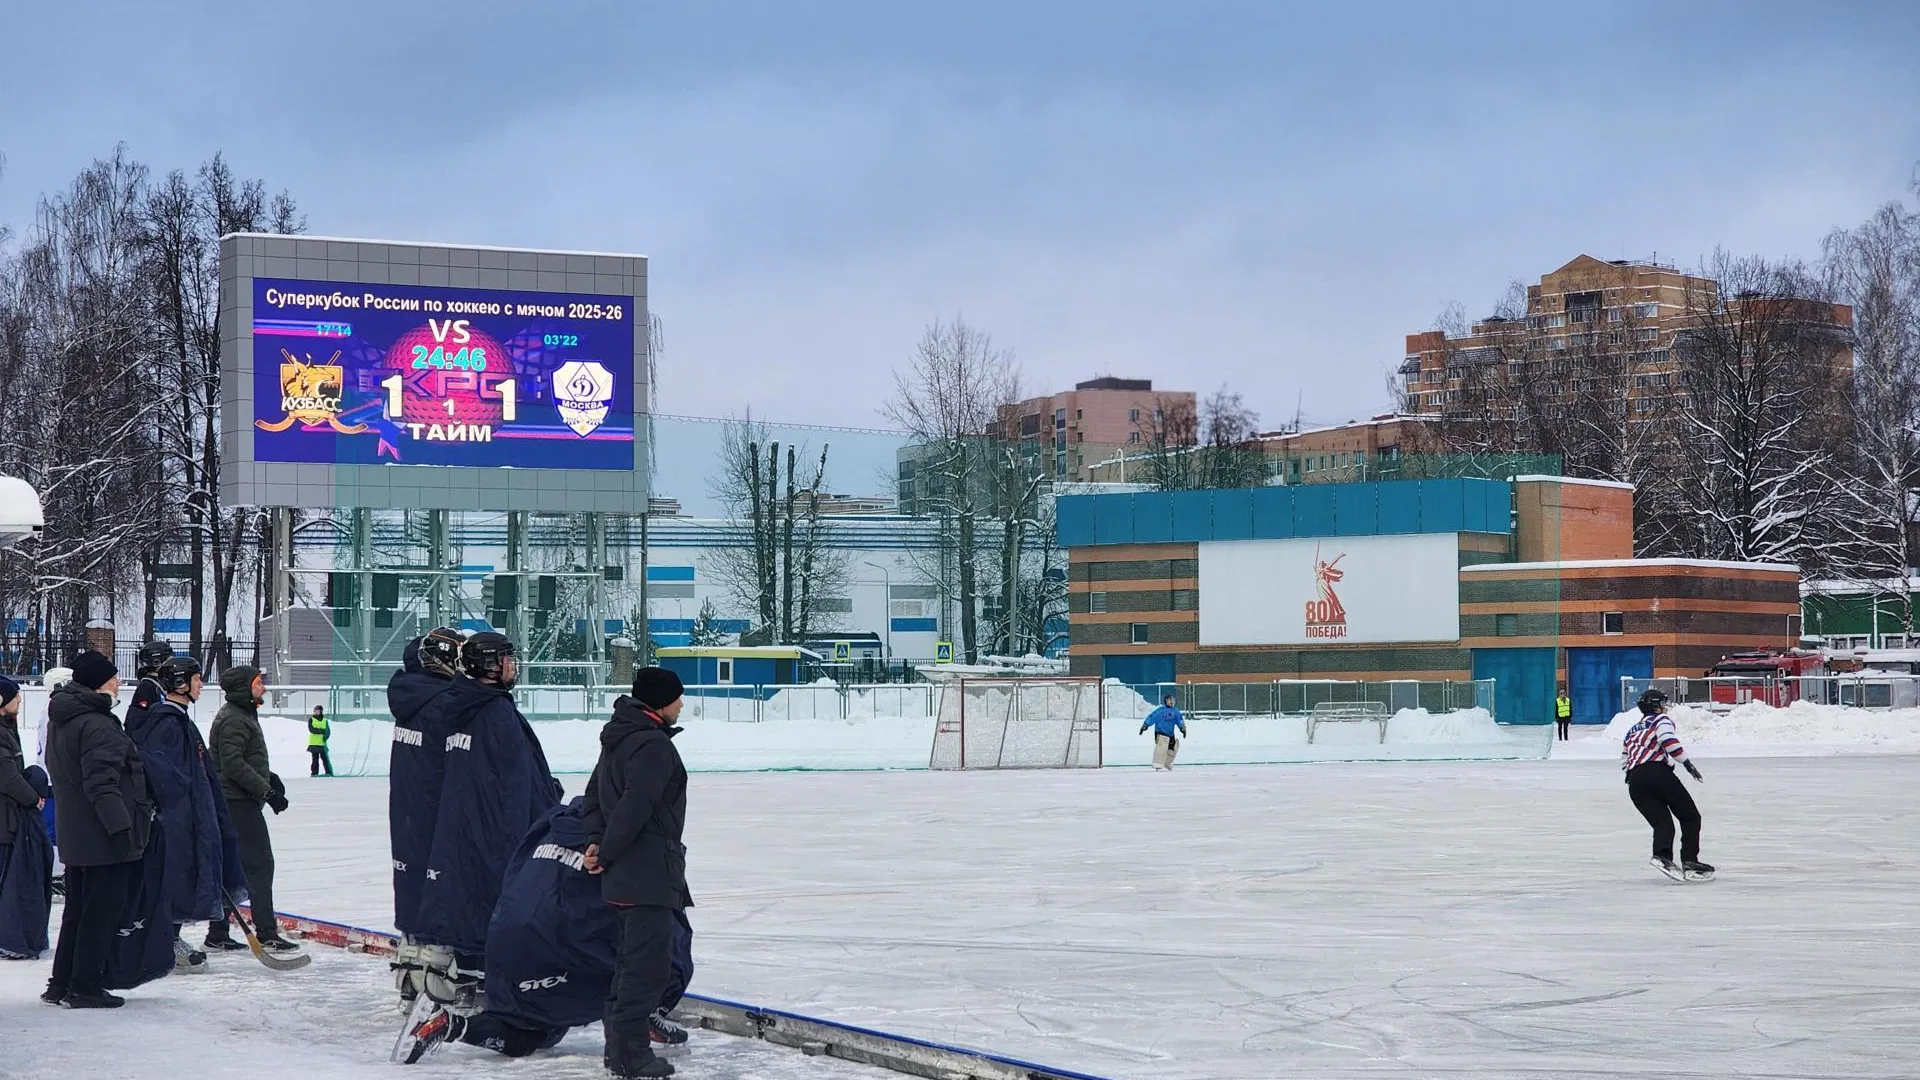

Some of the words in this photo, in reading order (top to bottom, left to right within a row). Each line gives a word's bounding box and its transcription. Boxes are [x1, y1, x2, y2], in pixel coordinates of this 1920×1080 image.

[266, 288, 360, 310] Суперкубок
[364, 293, 419, 310] России
[424, 299, 442, 312] по
[447, 301, 500, 315] хоккею
[504, 305, 513, 316] с
[517, 304, 565, 318] мячом
[568, 303, 622, 319] 2025-26
[428, 318, 471, 344] VS
[543, 334, 578, 346] 03'22
[412, 345, 486, 371] 24:46
[281, 396, 343, 413] КУЗБАСС
[381, 374, 403, 418] 1
[495, 379, 516, 421] 1
[561, 399, 604, 410] МОСКВА
[442, 399, 455, 416] 1
[406, 421, 492, 442] ТАЙМ
[1305, 600, 1329, 622] 80
[1305, 625, 1347, 639] ПОБЕДА!
[518, 971, 569, 993] STEX
